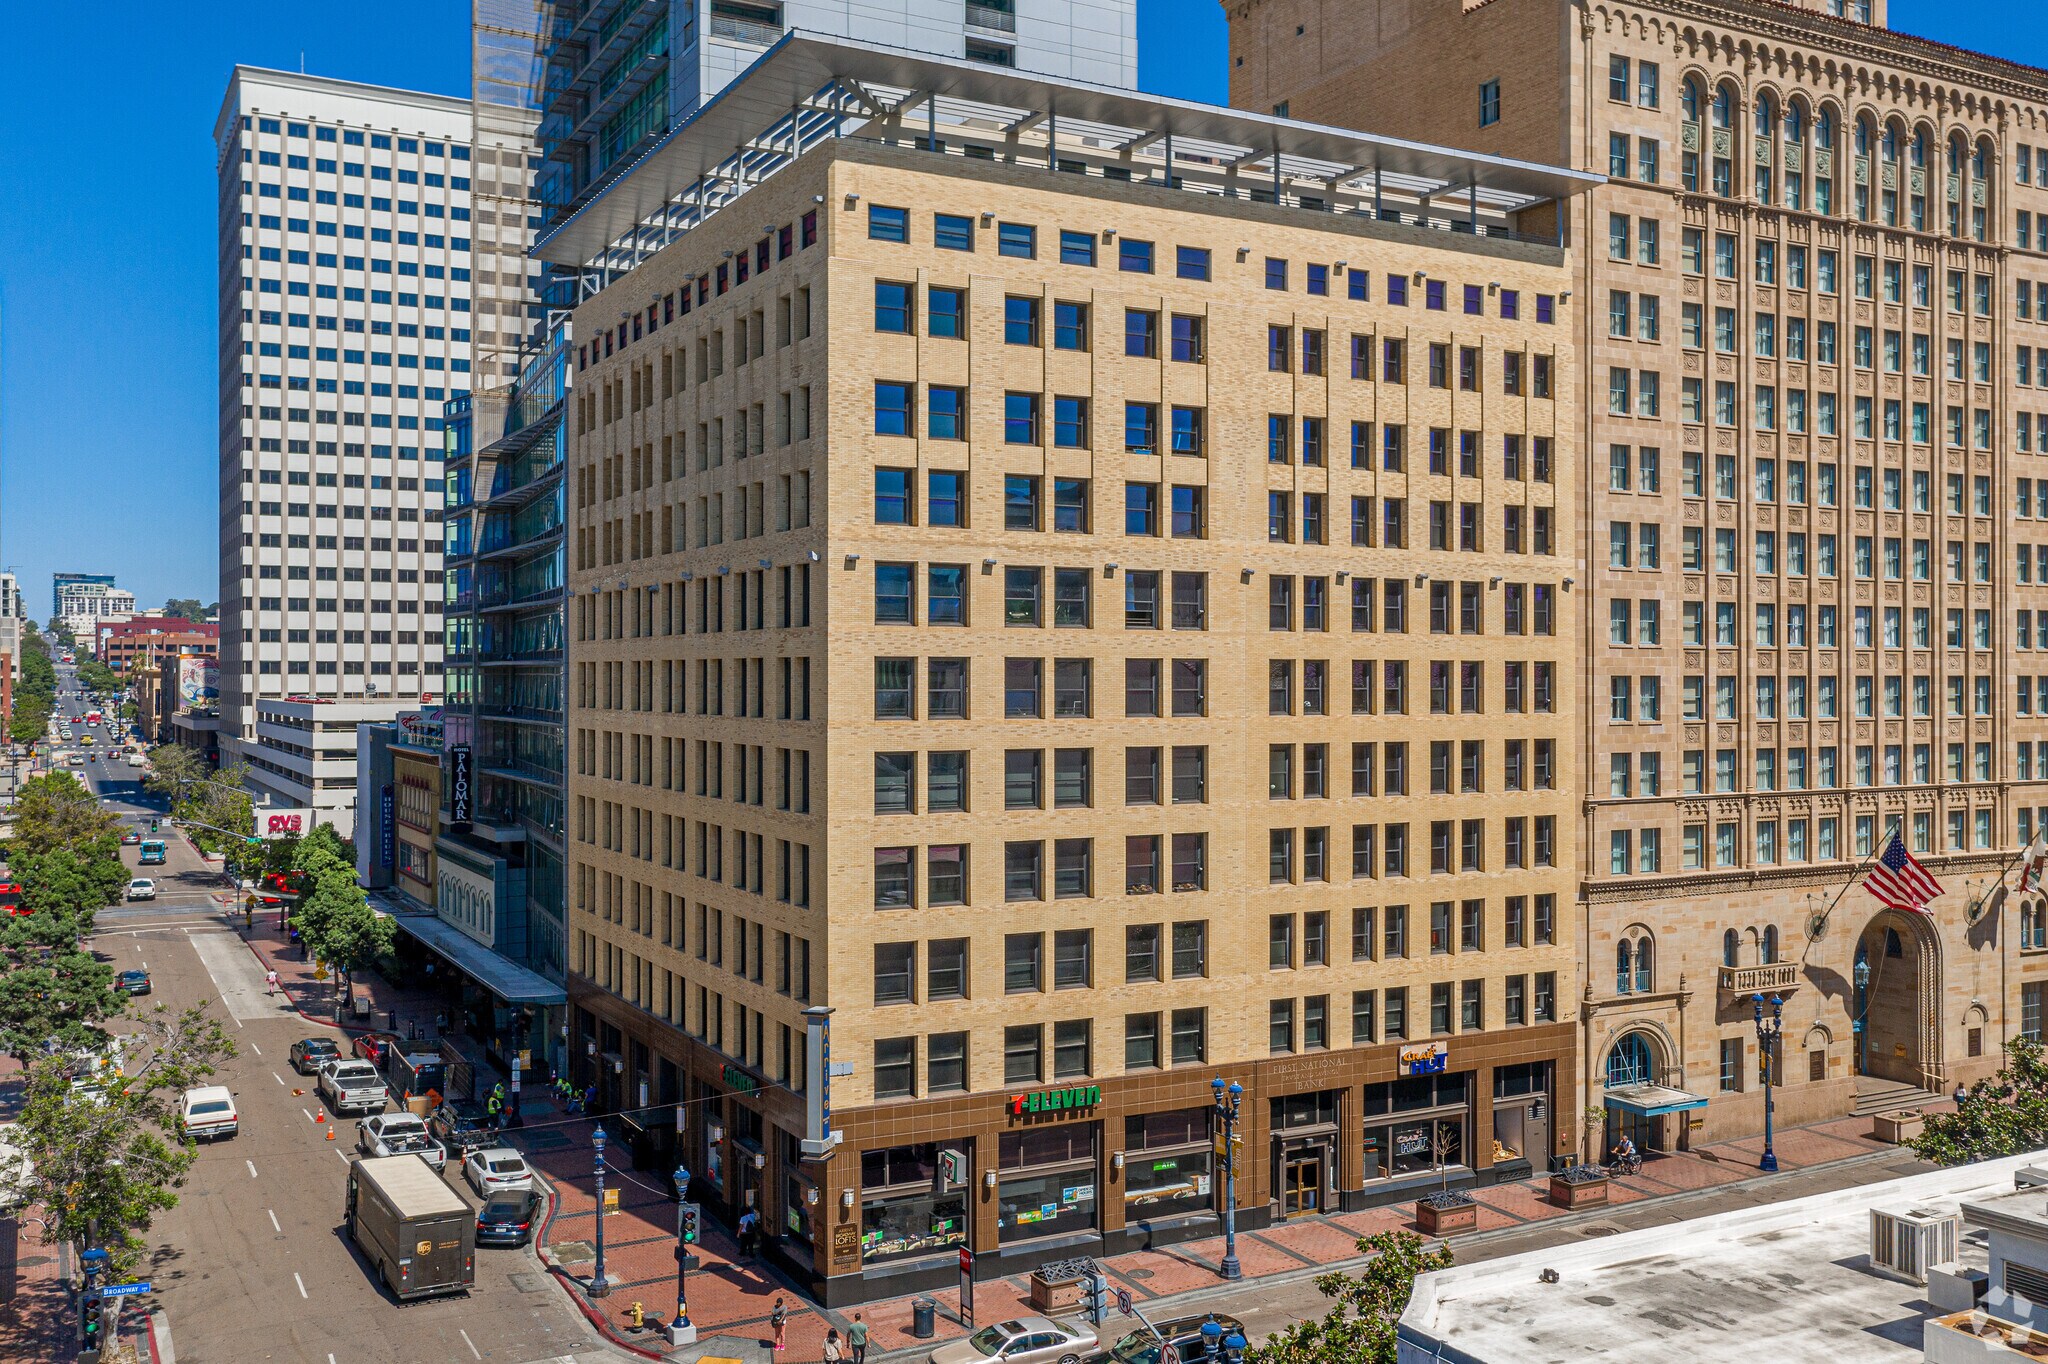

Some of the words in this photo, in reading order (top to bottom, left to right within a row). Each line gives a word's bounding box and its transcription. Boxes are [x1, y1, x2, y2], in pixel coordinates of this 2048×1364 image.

[455, 753, 468, 820] PALOMAR
[268, 815, 302, 828] CVS
[1273, 1064, 1296, 1074] FIRST
[1301, 1057, 1345, 1070] NATIONAL
[1411, 1053, 1448, 1075] HUT
[1297, 1079, 1324, 1090] BANK
[1401, 1137, 1427, 1153] HUT
[836, 1236, 857, 1245] LOFTS
[103, 1286, 139, 1296] BROADWAY
